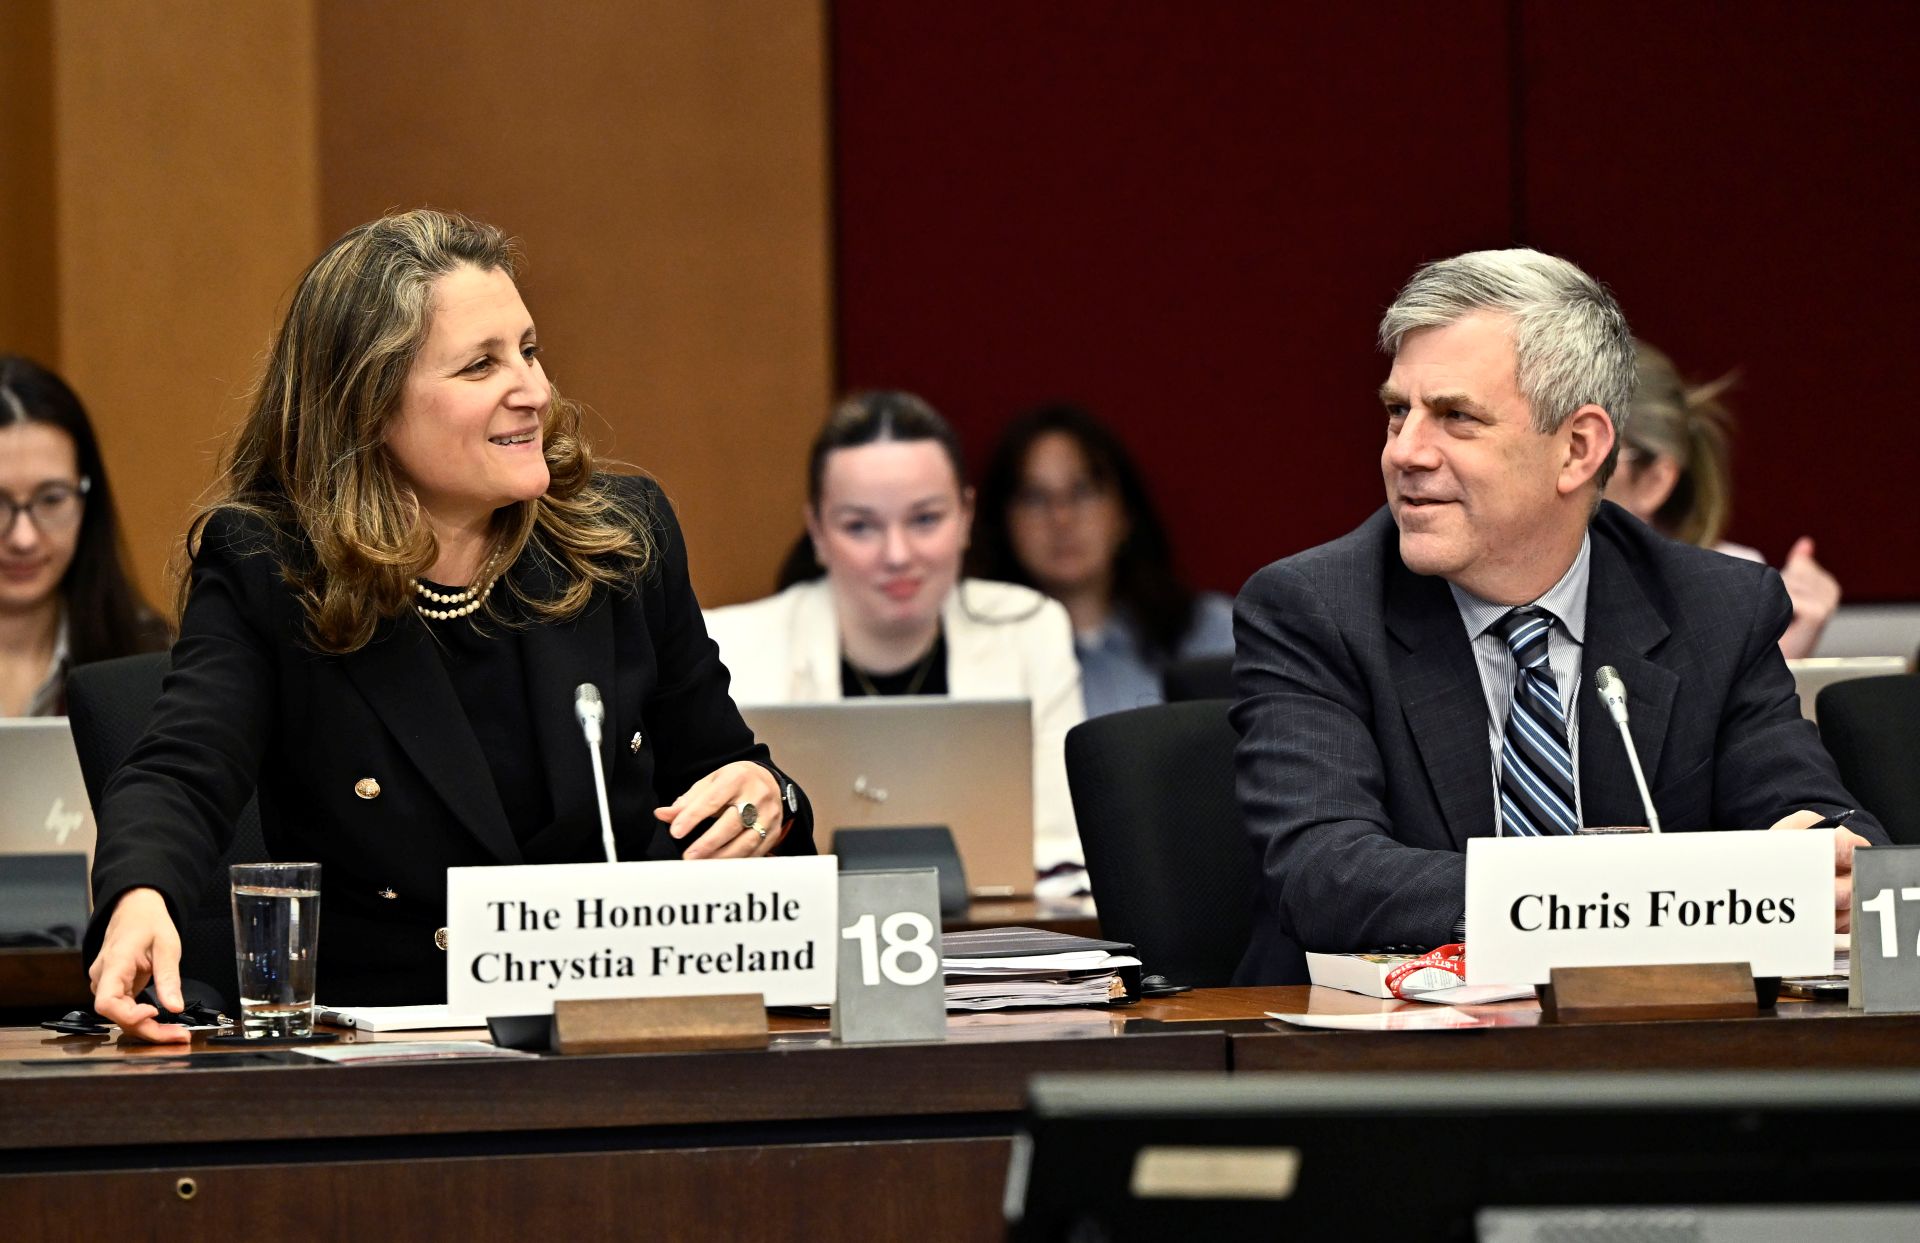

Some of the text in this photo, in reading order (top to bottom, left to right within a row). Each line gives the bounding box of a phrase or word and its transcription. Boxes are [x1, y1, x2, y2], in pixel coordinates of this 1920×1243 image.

[487, 891, 800, 932] The Honourable
[1509, 888, 1796, 932] Chris Forbes
[470, 940, 815, 990] Chrystia Freeland
[842, 911, 939, 986] 18
